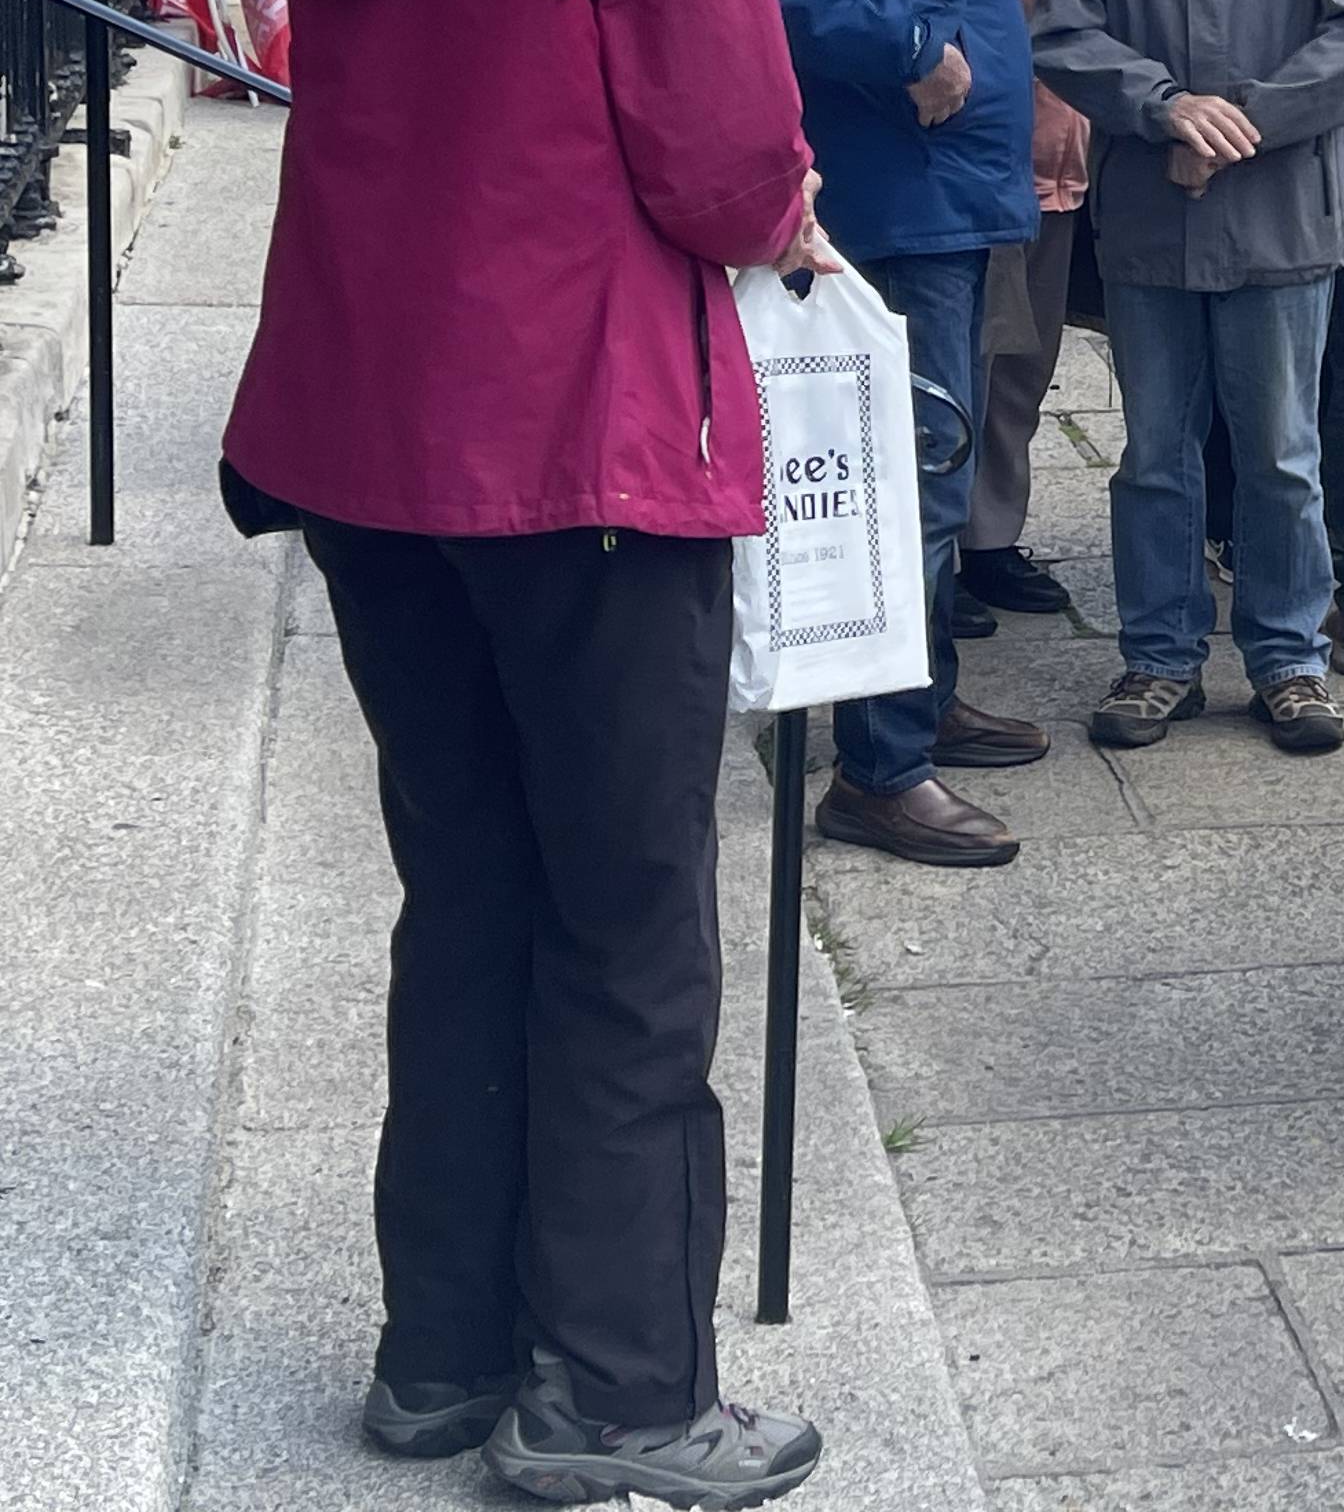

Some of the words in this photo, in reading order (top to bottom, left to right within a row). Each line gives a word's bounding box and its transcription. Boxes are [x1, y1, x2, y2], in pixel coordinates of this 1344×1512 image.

[780, 448, 849, 484] ee's
[780, 489, 862, 523] NDIES
[814, 545, 845, 561] 1921
